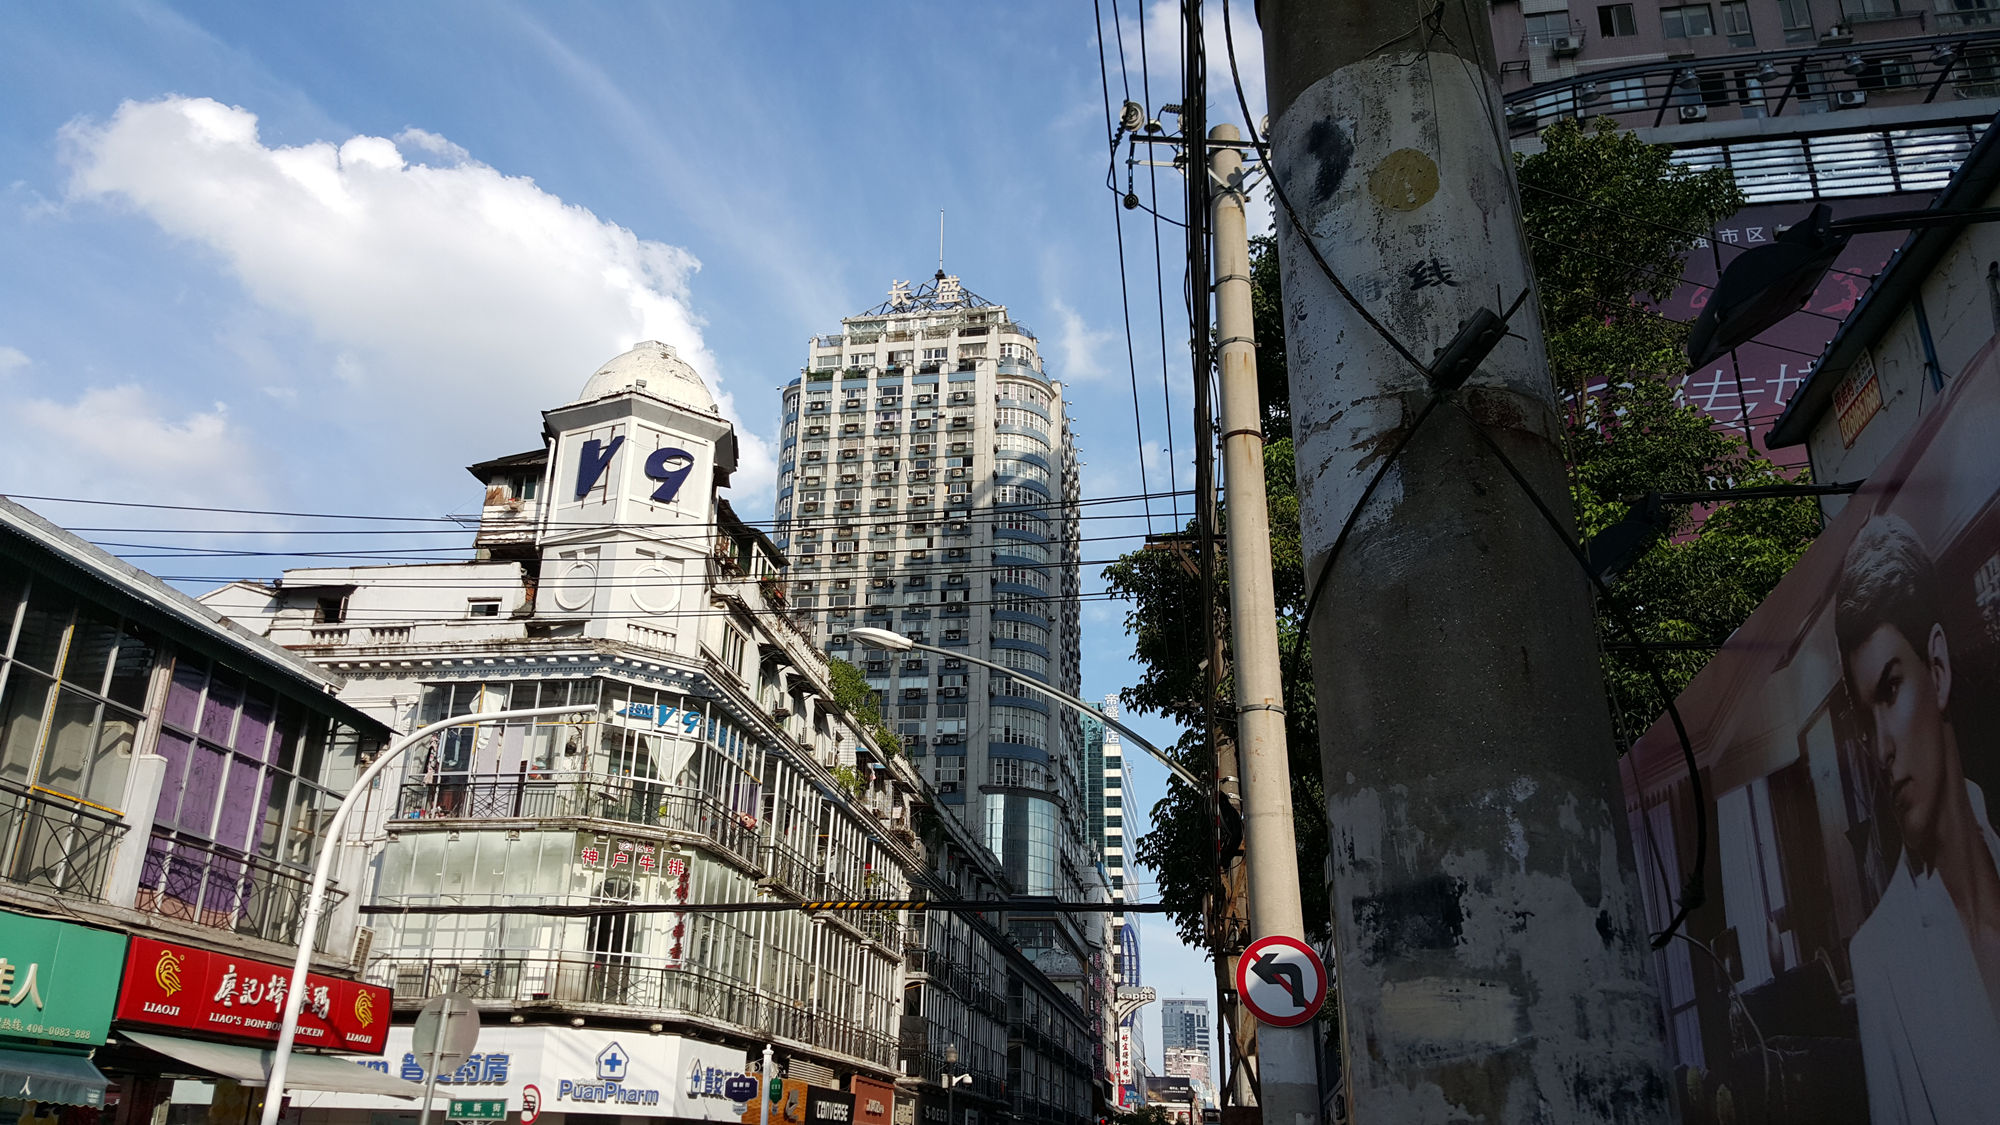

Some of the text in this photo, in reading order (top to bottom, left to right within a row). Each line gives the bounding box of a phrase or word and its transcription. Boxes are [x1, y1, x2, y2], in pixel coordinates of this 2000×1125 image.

[888, 275, 960, 307] 长盛
[1104, 692, 1120, 744] 帝盛店
[581, 847, 686, 877] 神户牛排
[1117, 991, 1156, 1001] Kappa
[143, 1002, 180, 1016] LIAOJI
[295, 1025, 325, 1037] ICKEN
[345, 1032, 373, 1044] LIAOJI
[401, 1053, 510, 1083] 普药房
[558, 1079, 660, 1106] PuanPharm
[816, 1100, 849, 1120] CONVERSE
